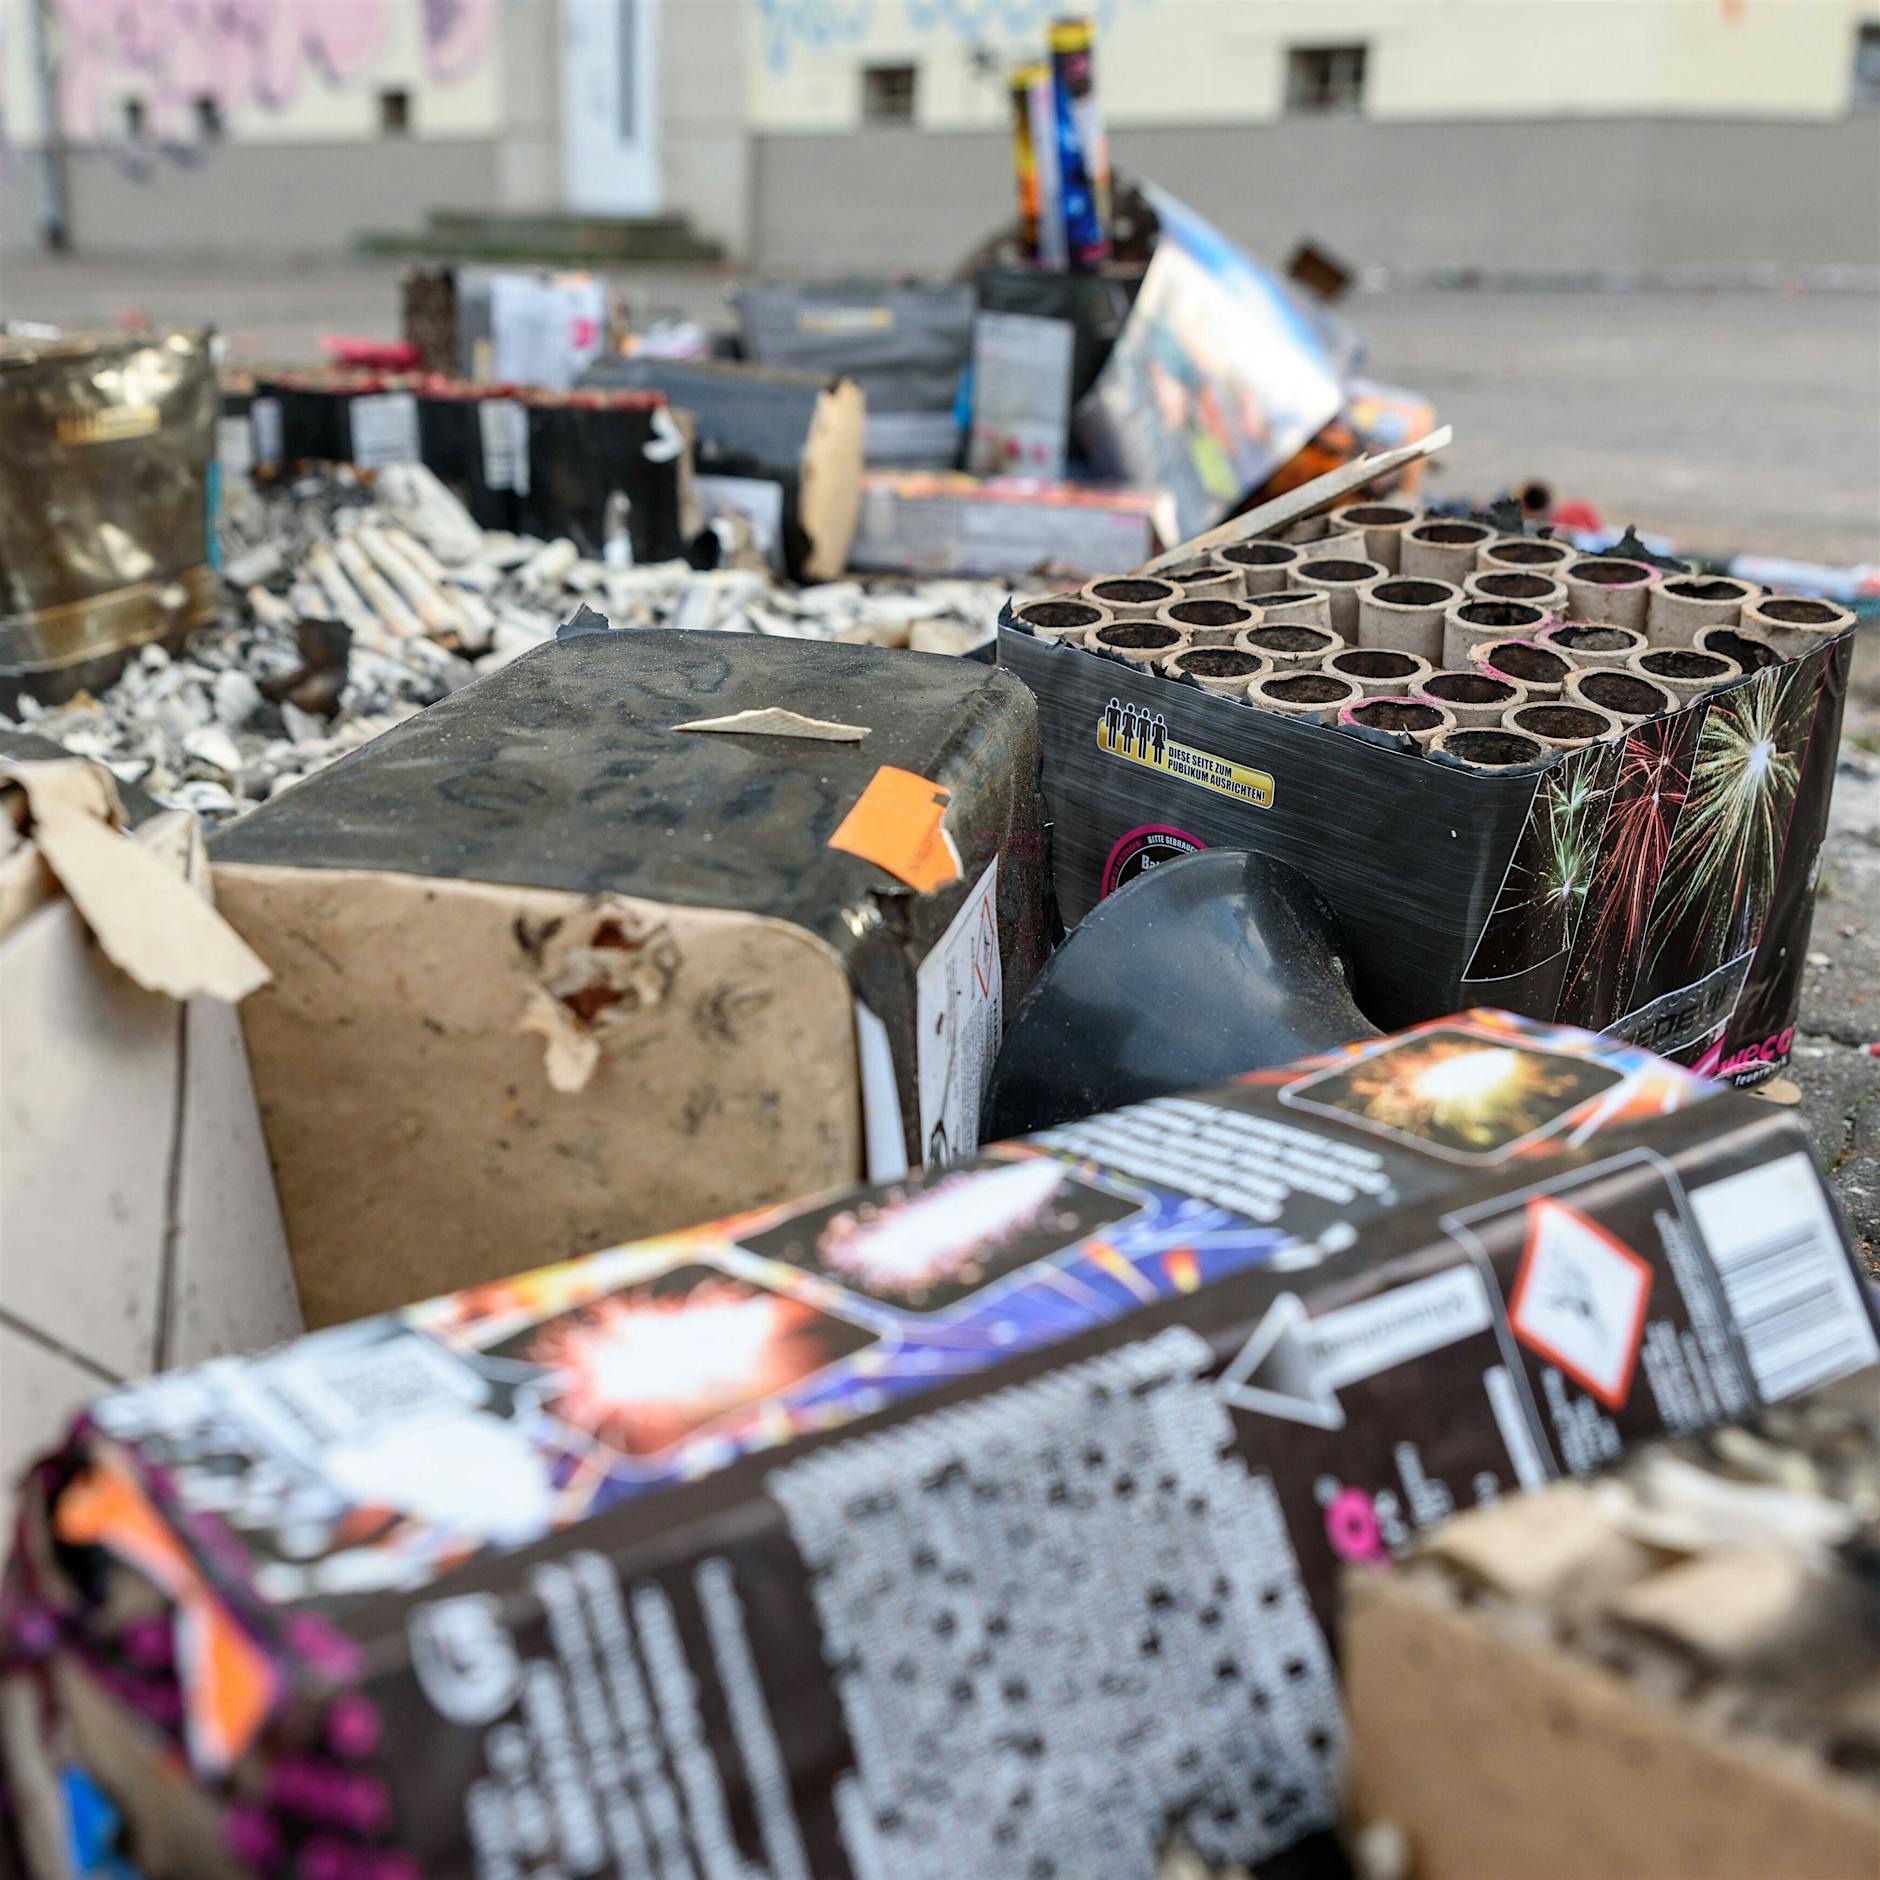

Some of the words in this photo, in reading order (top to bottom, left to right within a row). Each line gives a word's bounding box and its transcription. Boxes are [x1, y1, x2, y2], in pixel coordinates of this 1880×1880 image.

[1167, 759, 1209, 782] PUBLIKUM
[1210, 774, 1265, 802] AUSRICHTEN!
[1168, 746, 1191, 763] DIESE
[1192, 754, 1214, 772] SEITE
[1215, 762, 1232, 778] ZUM
[1147, 834, 1165, 845] BITTE
[1165, 836, 1198, 853] GEBRAUC
[1720, 1026, 1793, 1073] weco
